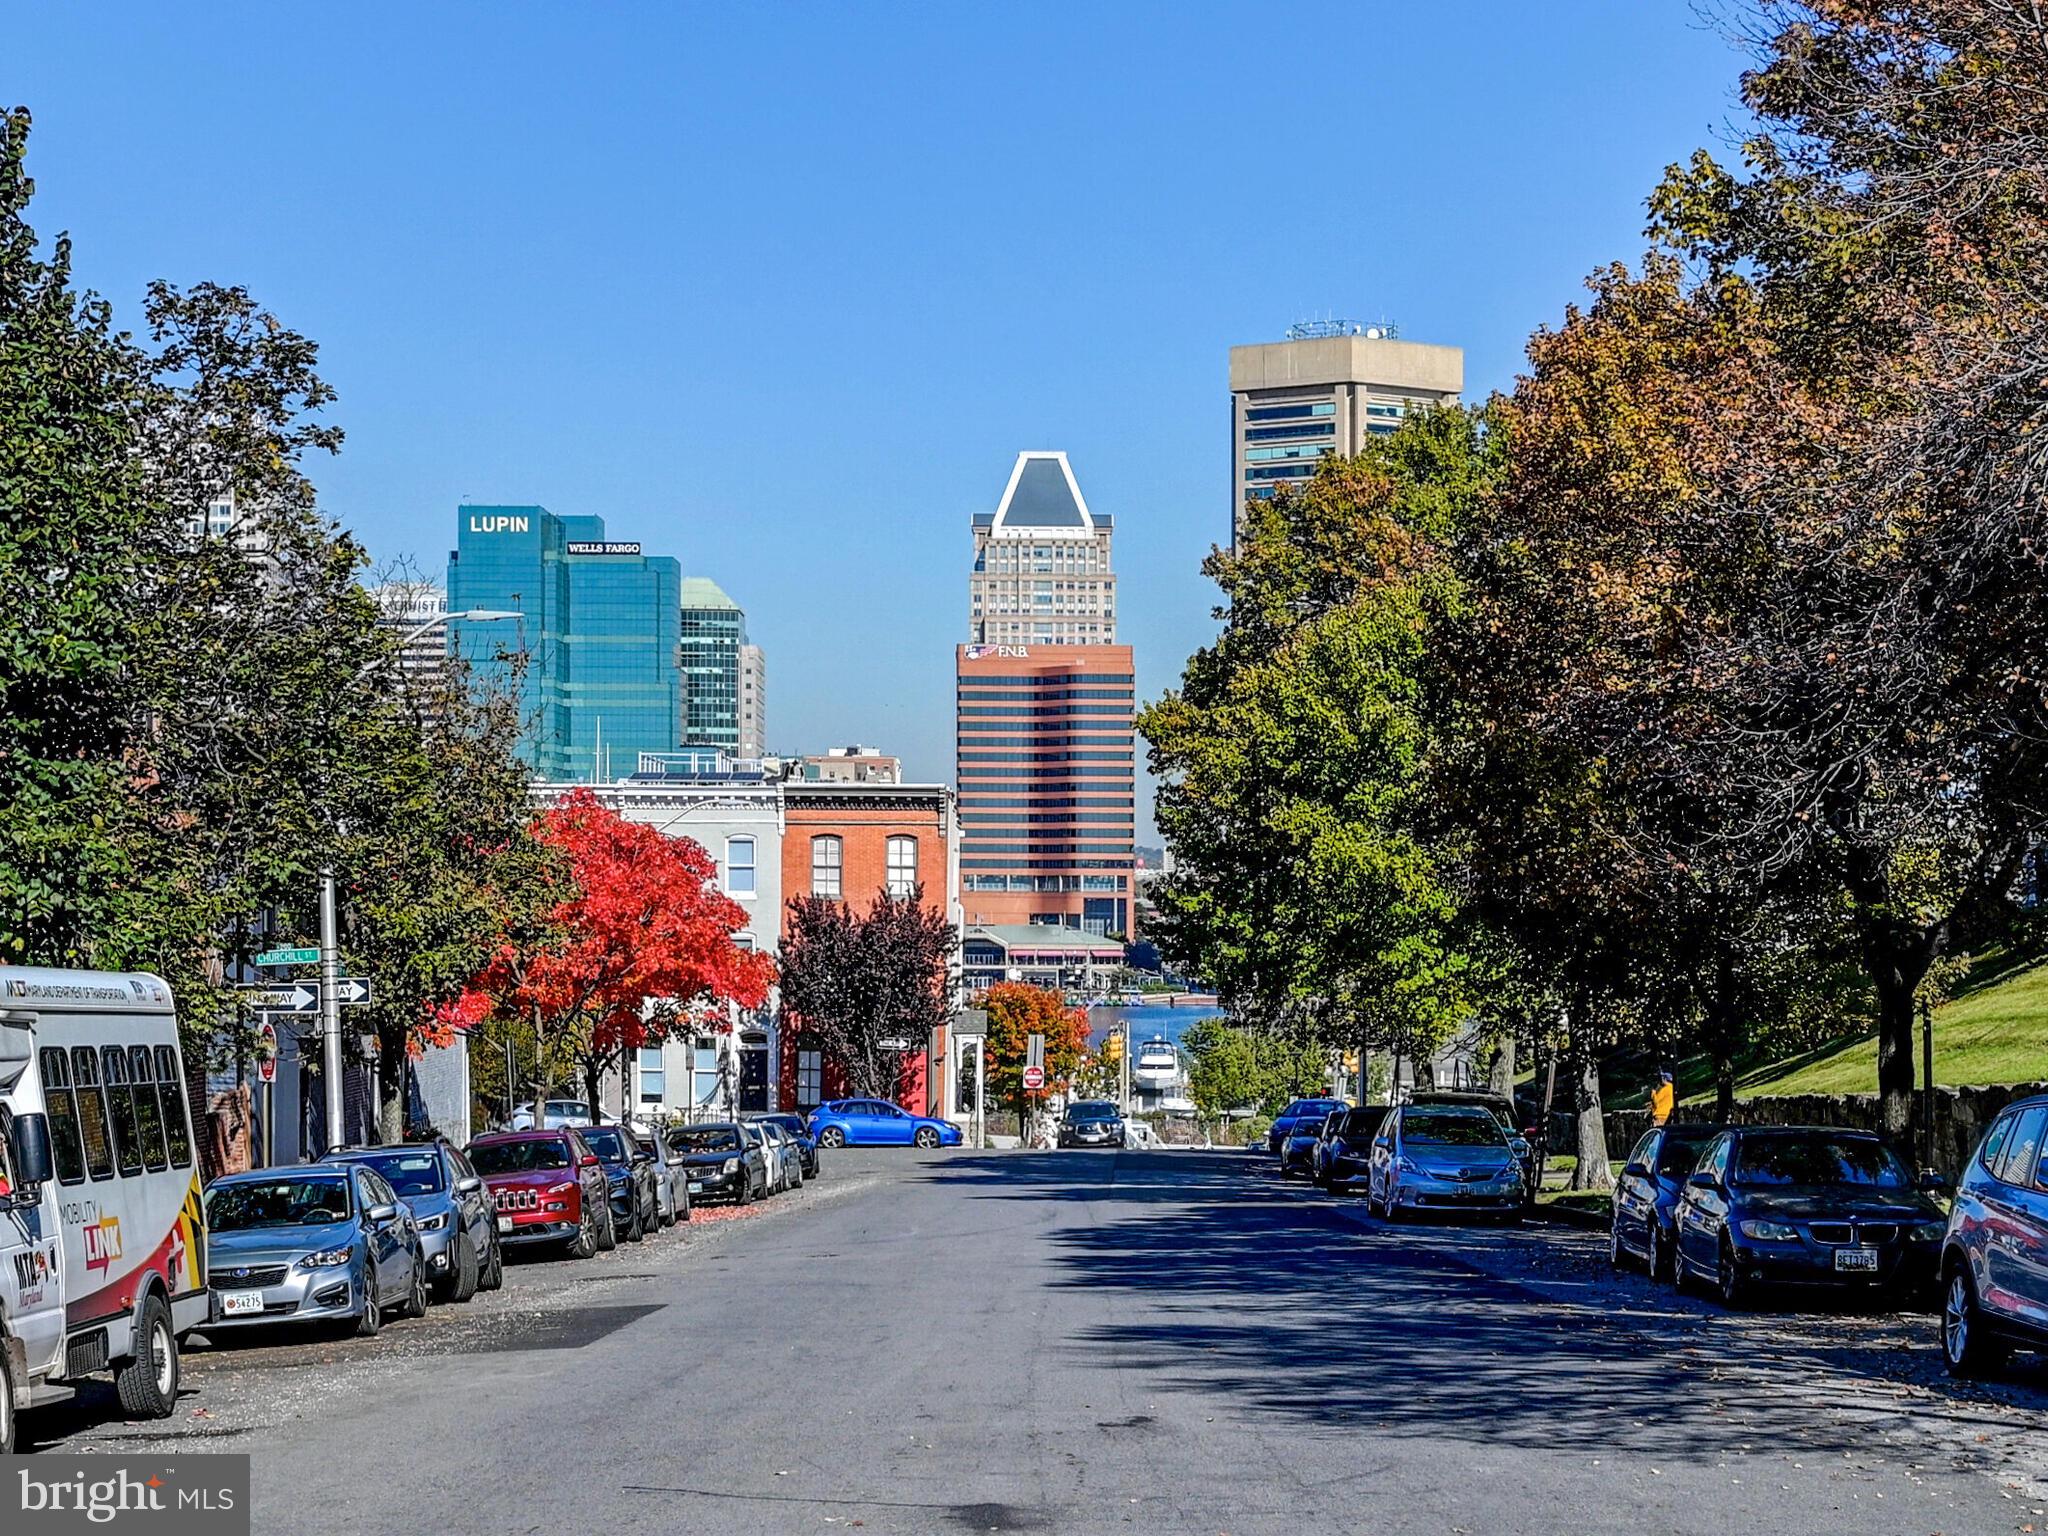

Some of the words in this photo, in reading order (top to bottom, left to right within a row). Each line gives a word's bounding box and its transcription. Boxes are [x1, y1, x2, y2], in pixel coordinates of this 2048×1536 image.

[470, 516, 529, 533] LUPIN
[568, 543, 603, 553] WELLS
[605, 543, 640, 553] FARGO
[256, 951, 303, 963] CHURCHILL
[61, 1200, 98, 1227] MOBILITY
[85, 1225, 122, 1262] LINK
[13, 1251, 38, 1291] MTA
